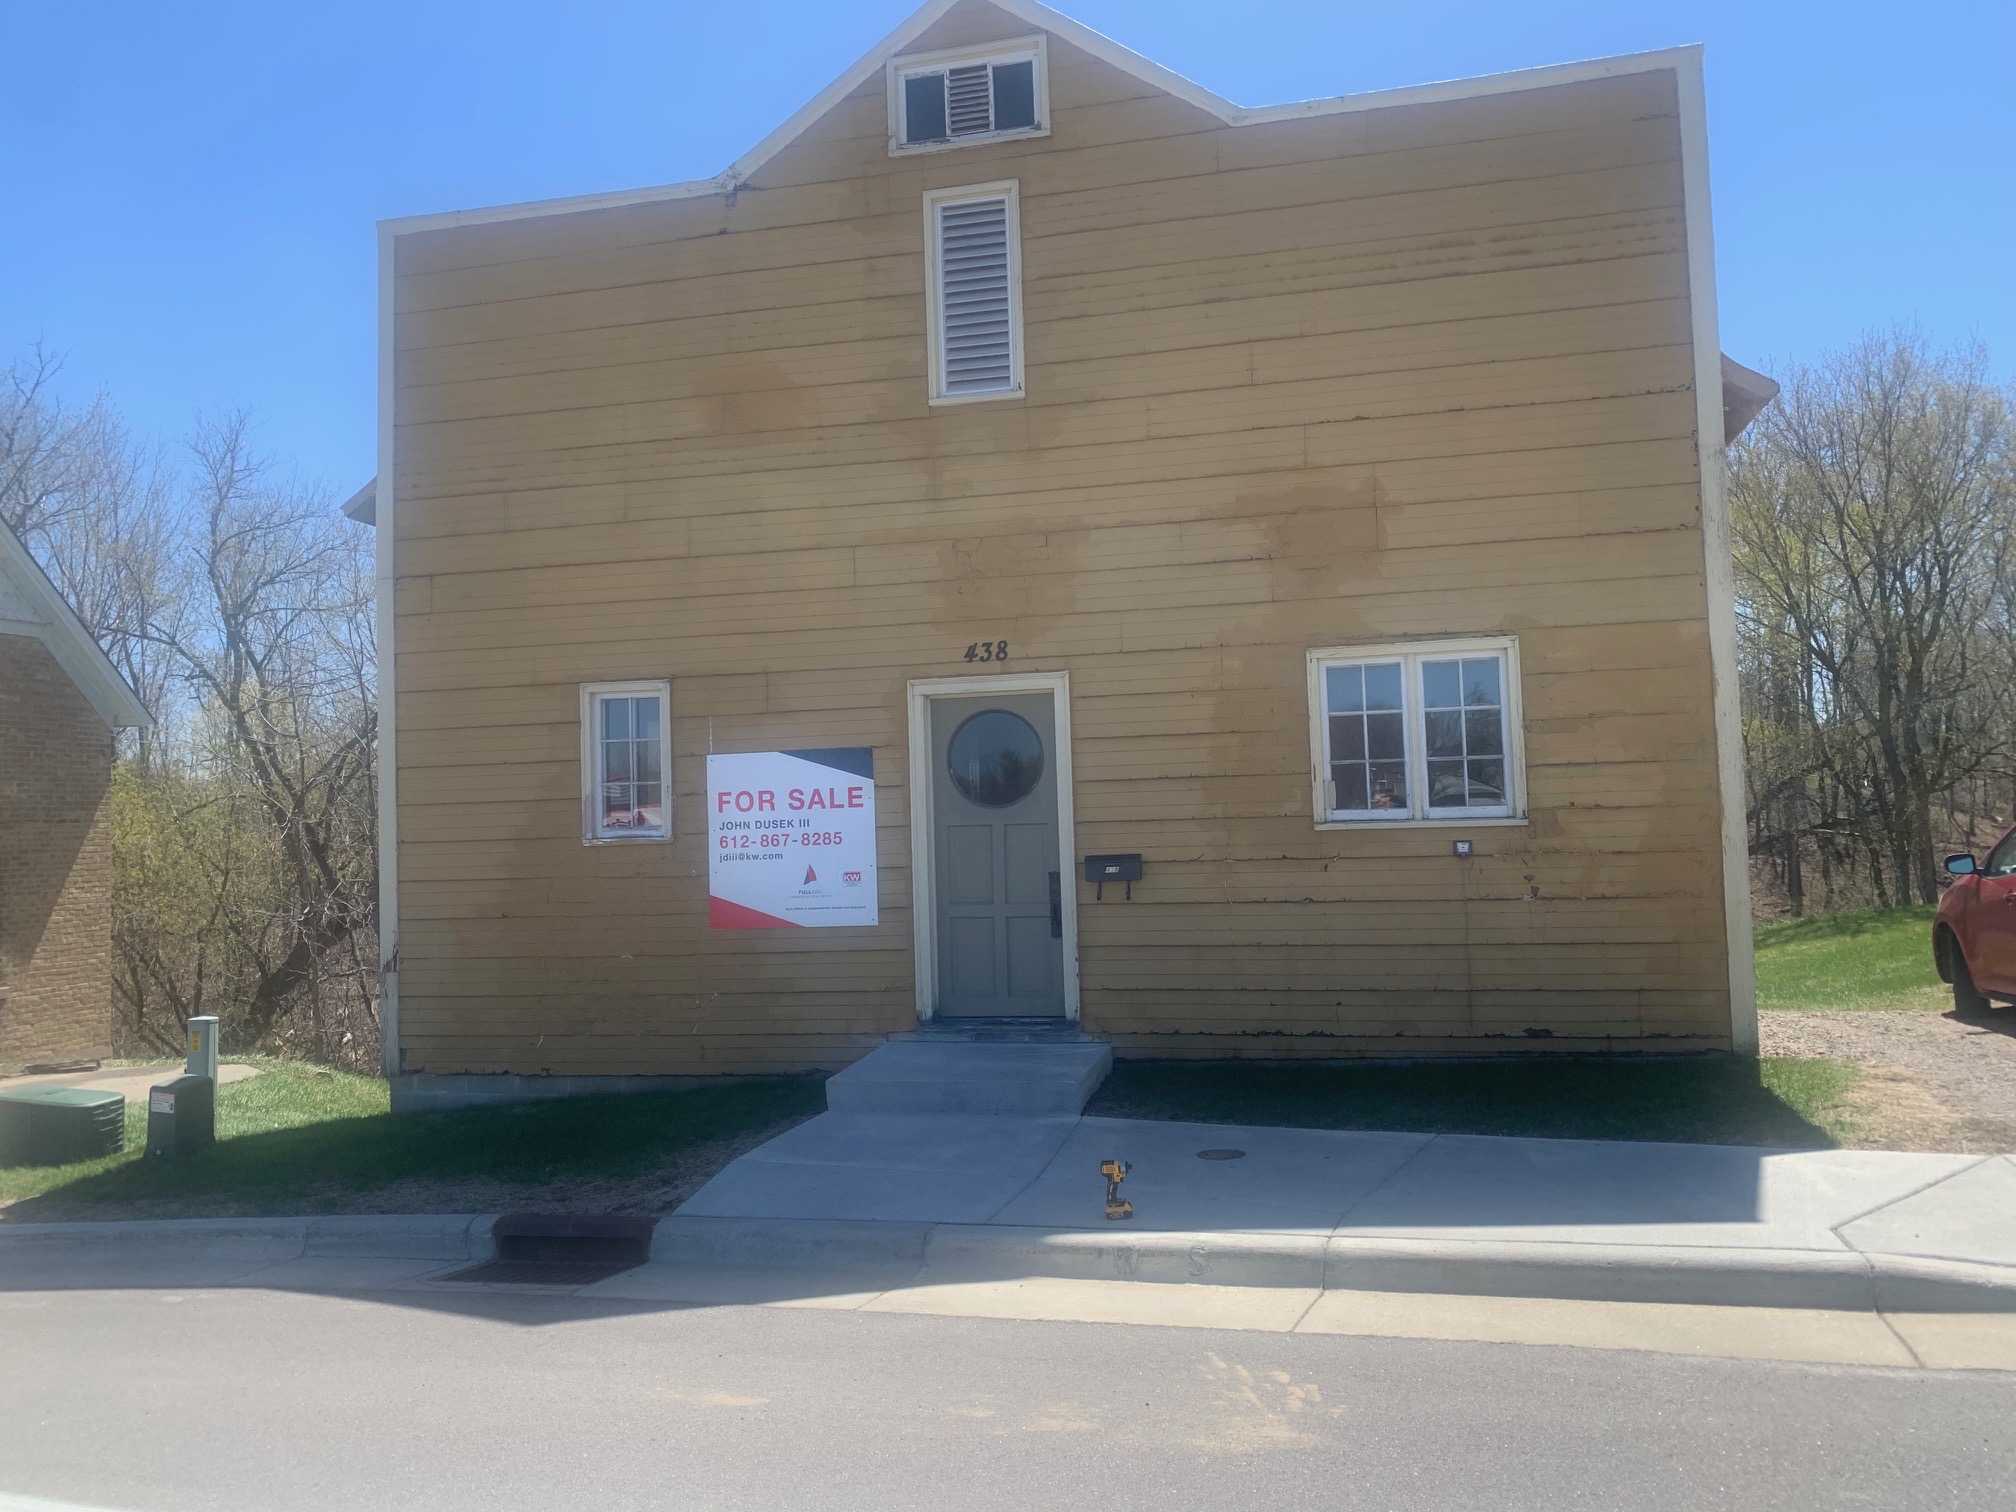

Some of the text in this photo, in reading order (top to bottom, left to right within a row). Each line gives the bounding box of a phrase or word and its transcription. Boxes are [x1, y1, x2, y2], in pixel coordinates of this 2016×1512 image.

[964, 640, 1008, 663] 438
[717, 786, 864, 813] FOR SALE
[719, 818, 810, 831] JOHN DUSEK III
[719, 832, 843, 849] 612-867-8285
[719, 852, 783, 863] jdiii@kw.com
